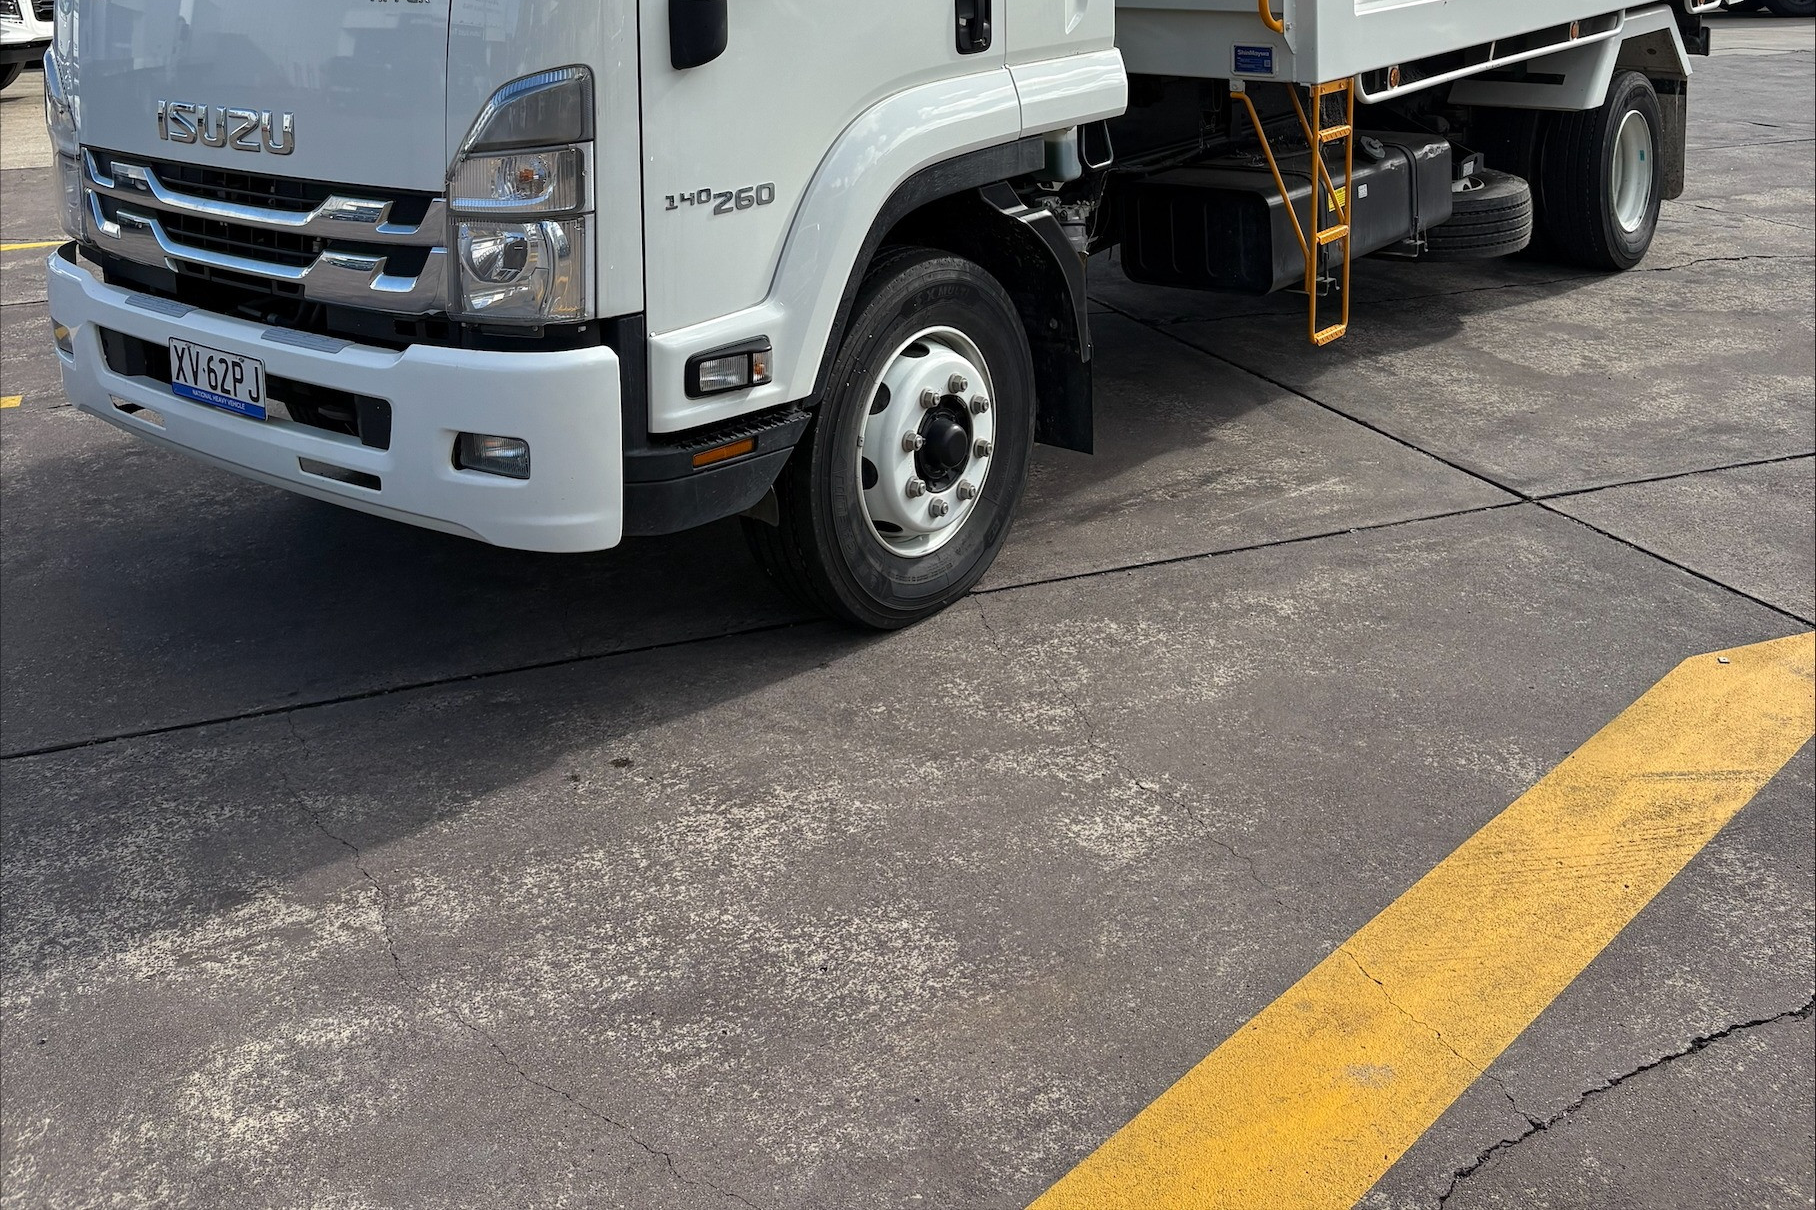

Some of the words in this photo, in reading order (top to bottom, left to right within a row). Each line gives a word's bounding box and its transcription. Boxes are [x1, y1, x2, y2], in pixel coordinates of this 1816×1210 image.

[157, 99, 296, 156] ISUZU
[713, 181, 775, 216] 260
[192, 389, 213, 401] NATIONAL
[212, 395, 227, 405] HEAVY
[227, 398, 246, 411] VEHICLE
